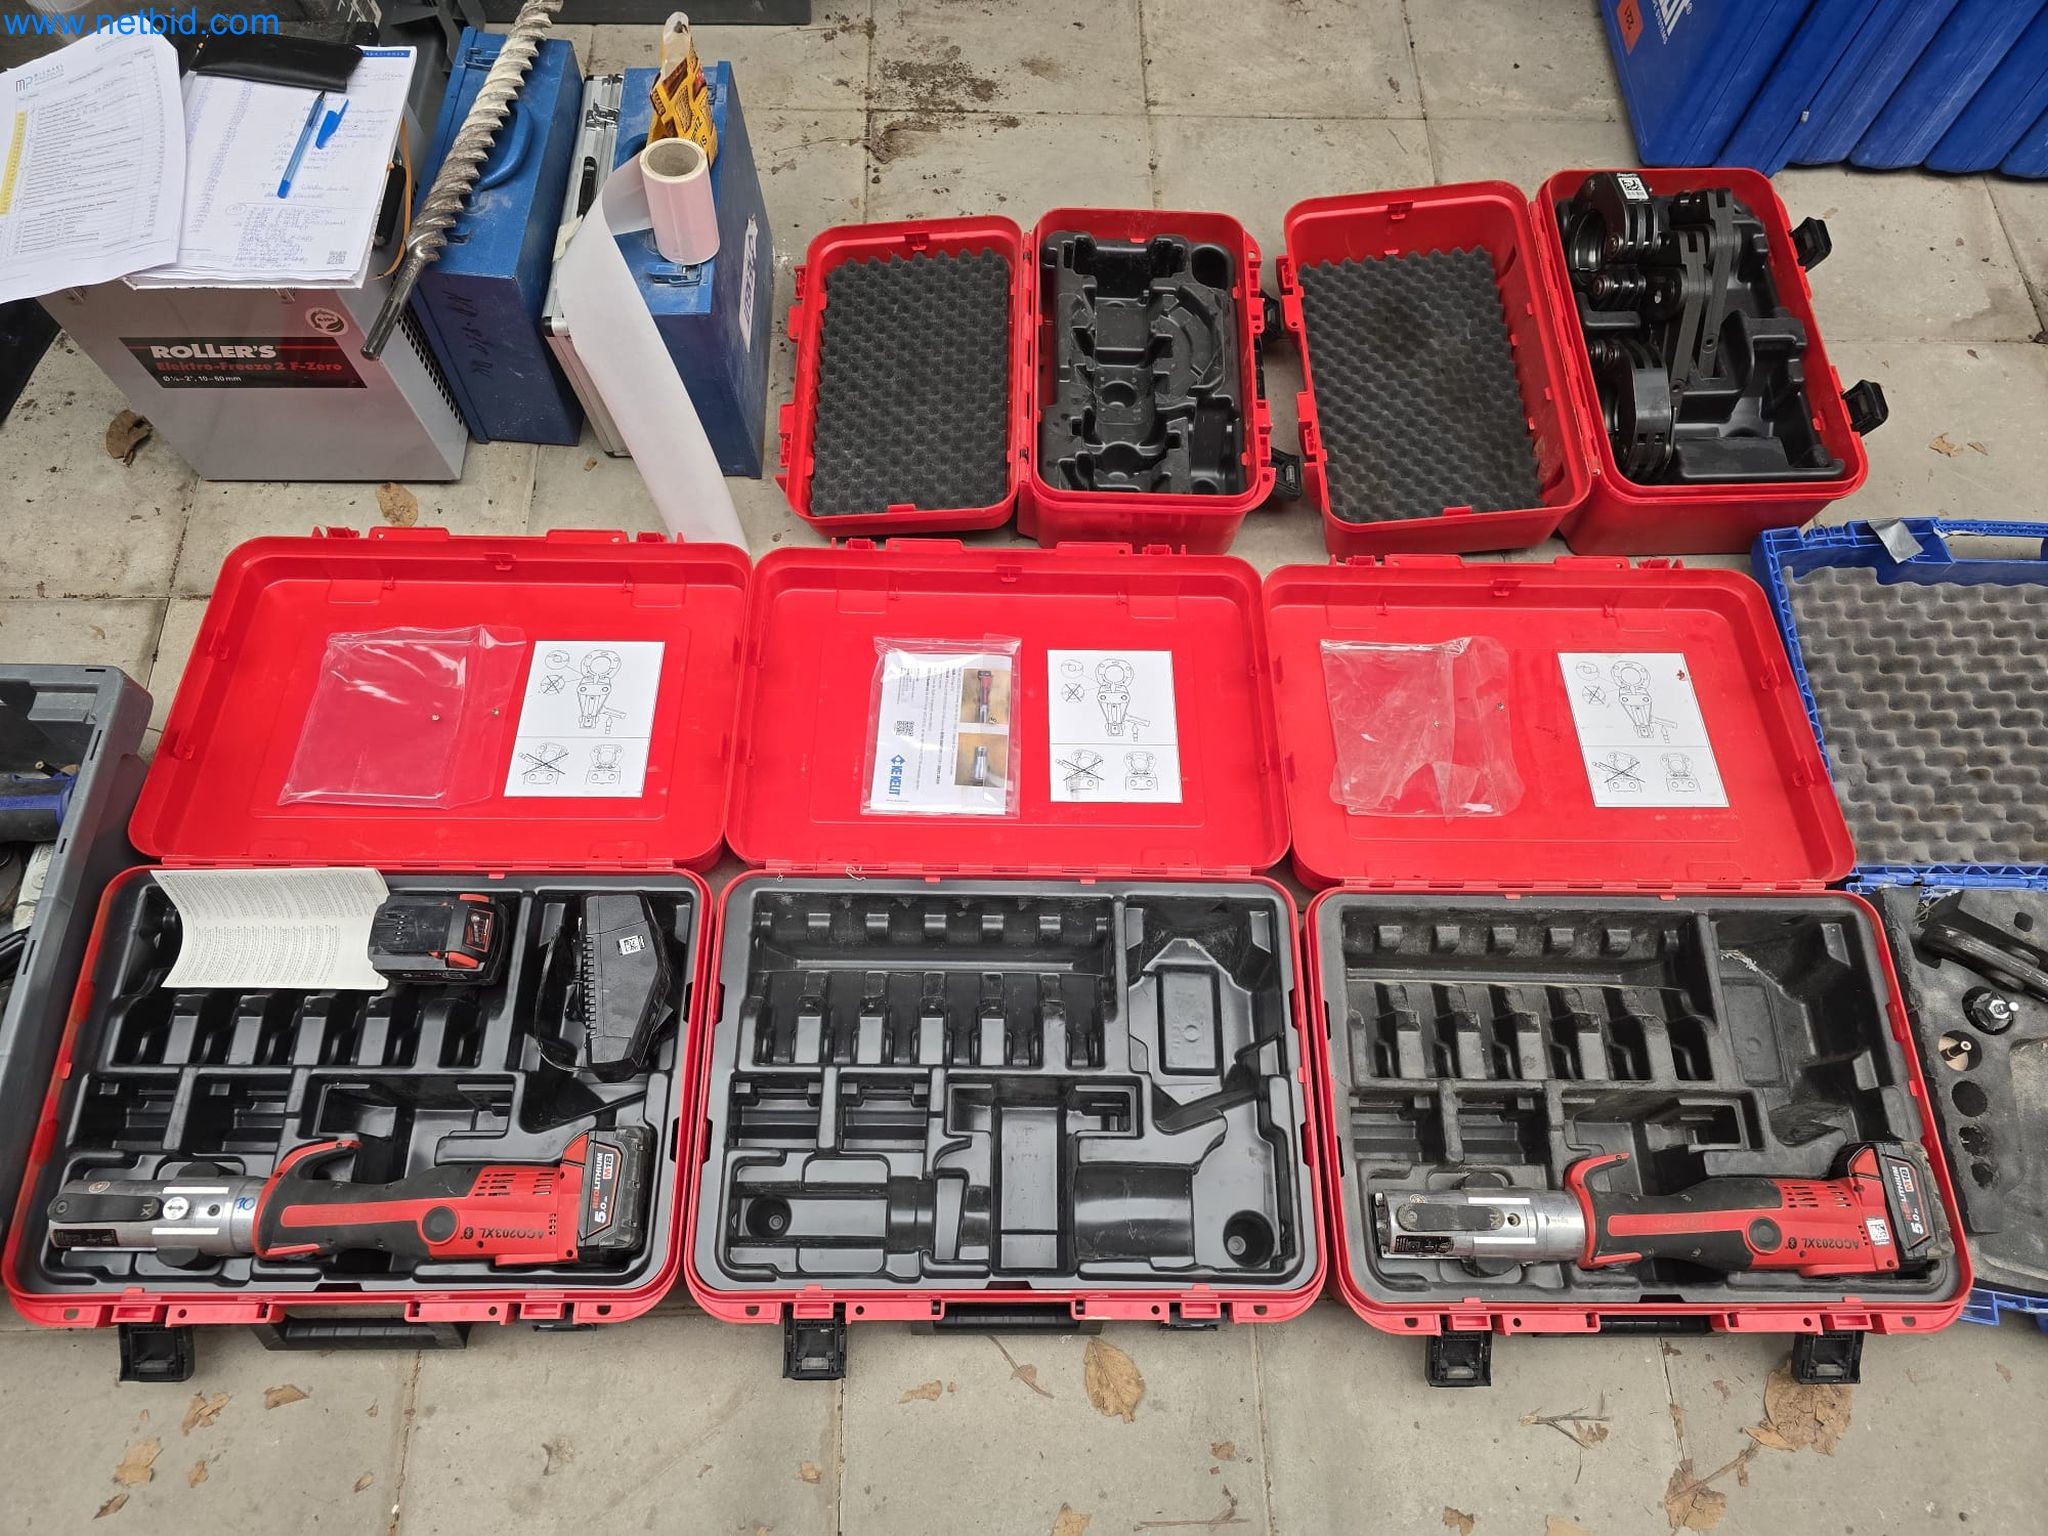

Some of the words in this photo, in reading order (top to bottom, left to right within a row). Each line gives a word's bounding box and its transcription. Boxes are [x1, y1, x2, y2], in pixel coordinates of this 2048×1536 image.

[150, 343, 277, 359] ROLLER'S
[156, 361, 272, 371] Elektro-Freeze
[275, 361, 286, 371] 2
[290, 361, 342, 371] F-Zero
[603, 1155, 613, 1178] M18
[592, 1152, 603, 1209] REDLITHIUM
[1901, 1169, 1913, 1191] M18
[1892, 1165, 1912, 1222] REDLITHIUM
[595, 1202, 607, 1223] 5.0
[479, 1228, 544, 1240] ACO203XL
[1911, 1214, 1924, 1234] 5.0
[1801, 1238, 1860, 1250] ACO203XL
